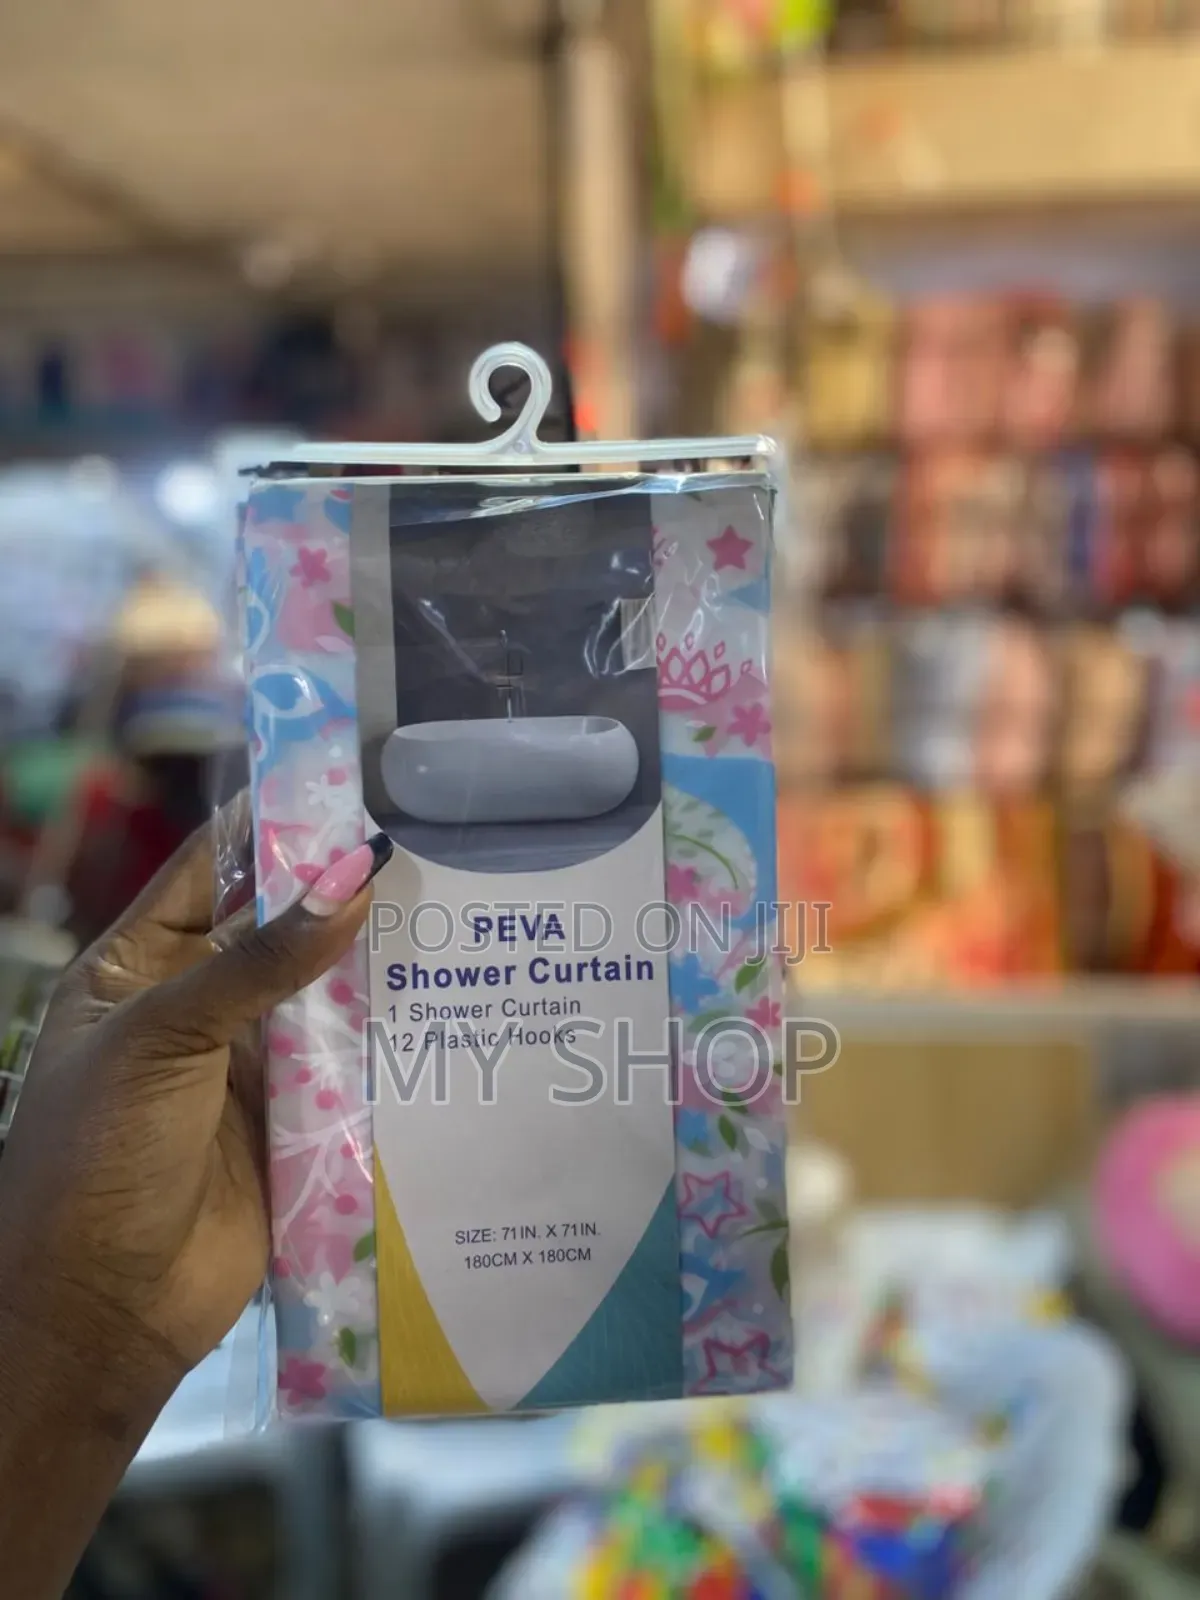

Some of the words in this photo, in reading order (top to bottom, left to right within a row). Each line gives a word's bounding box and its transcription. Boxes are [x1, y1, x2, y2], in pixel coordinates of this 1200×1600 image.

[473, 914, 566, 943] PEVA
[386, 961, 517, 990] Shower
[528, 954, 655, 984] Curtain
[388, 1005, 397, 1022] 1
[409, 1001, 493, 1021] Shower
[501, 997, 582, 1017] Curtain
[389, 1033, 414, 1053] 12
[424, 1029, 499, 1050] Plastic
[508, 1025, 576, 1046] Hooks
[455, 1228, 497, 1245] SIZE:
[546, 1224, 557, 1238] X
[464, 1252, 517, 1269] 180CM
[522, 1251, 533, 1264] X
[538, 1248, 591, 1263] 180CM
